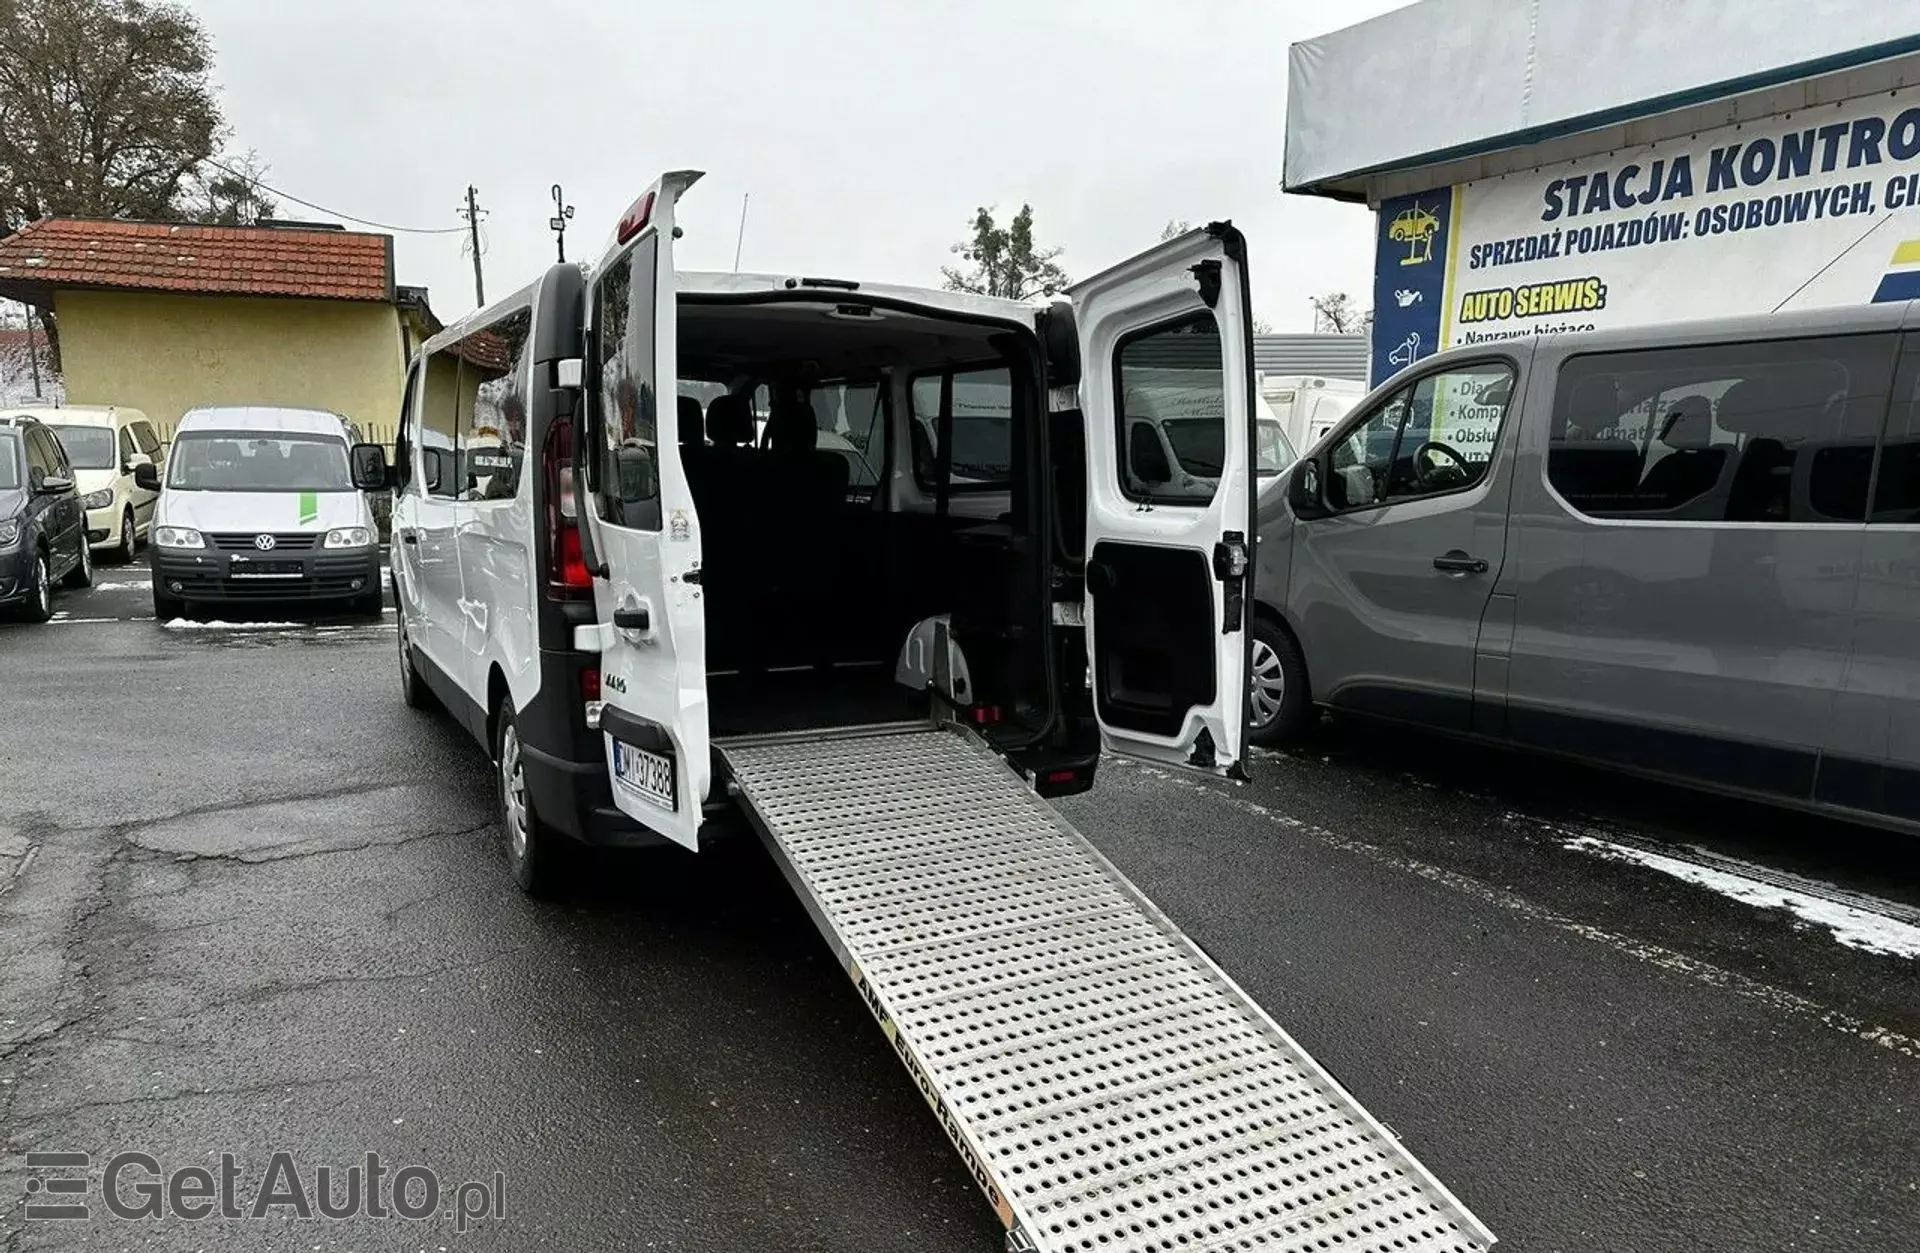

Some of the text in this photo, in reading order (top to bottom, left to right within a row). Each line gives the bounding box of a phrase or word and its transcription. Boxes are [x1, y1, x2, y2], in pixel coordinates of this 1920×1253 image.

[1541, 107, 1920, 221] STACJA KONTRO
[1470, 173, 1920, 269] SPRZEDAŻ POJAZDÓW: OSOBOWYCH, CI
[1460, 276, 1607, 323] AUTO SERWIS:
